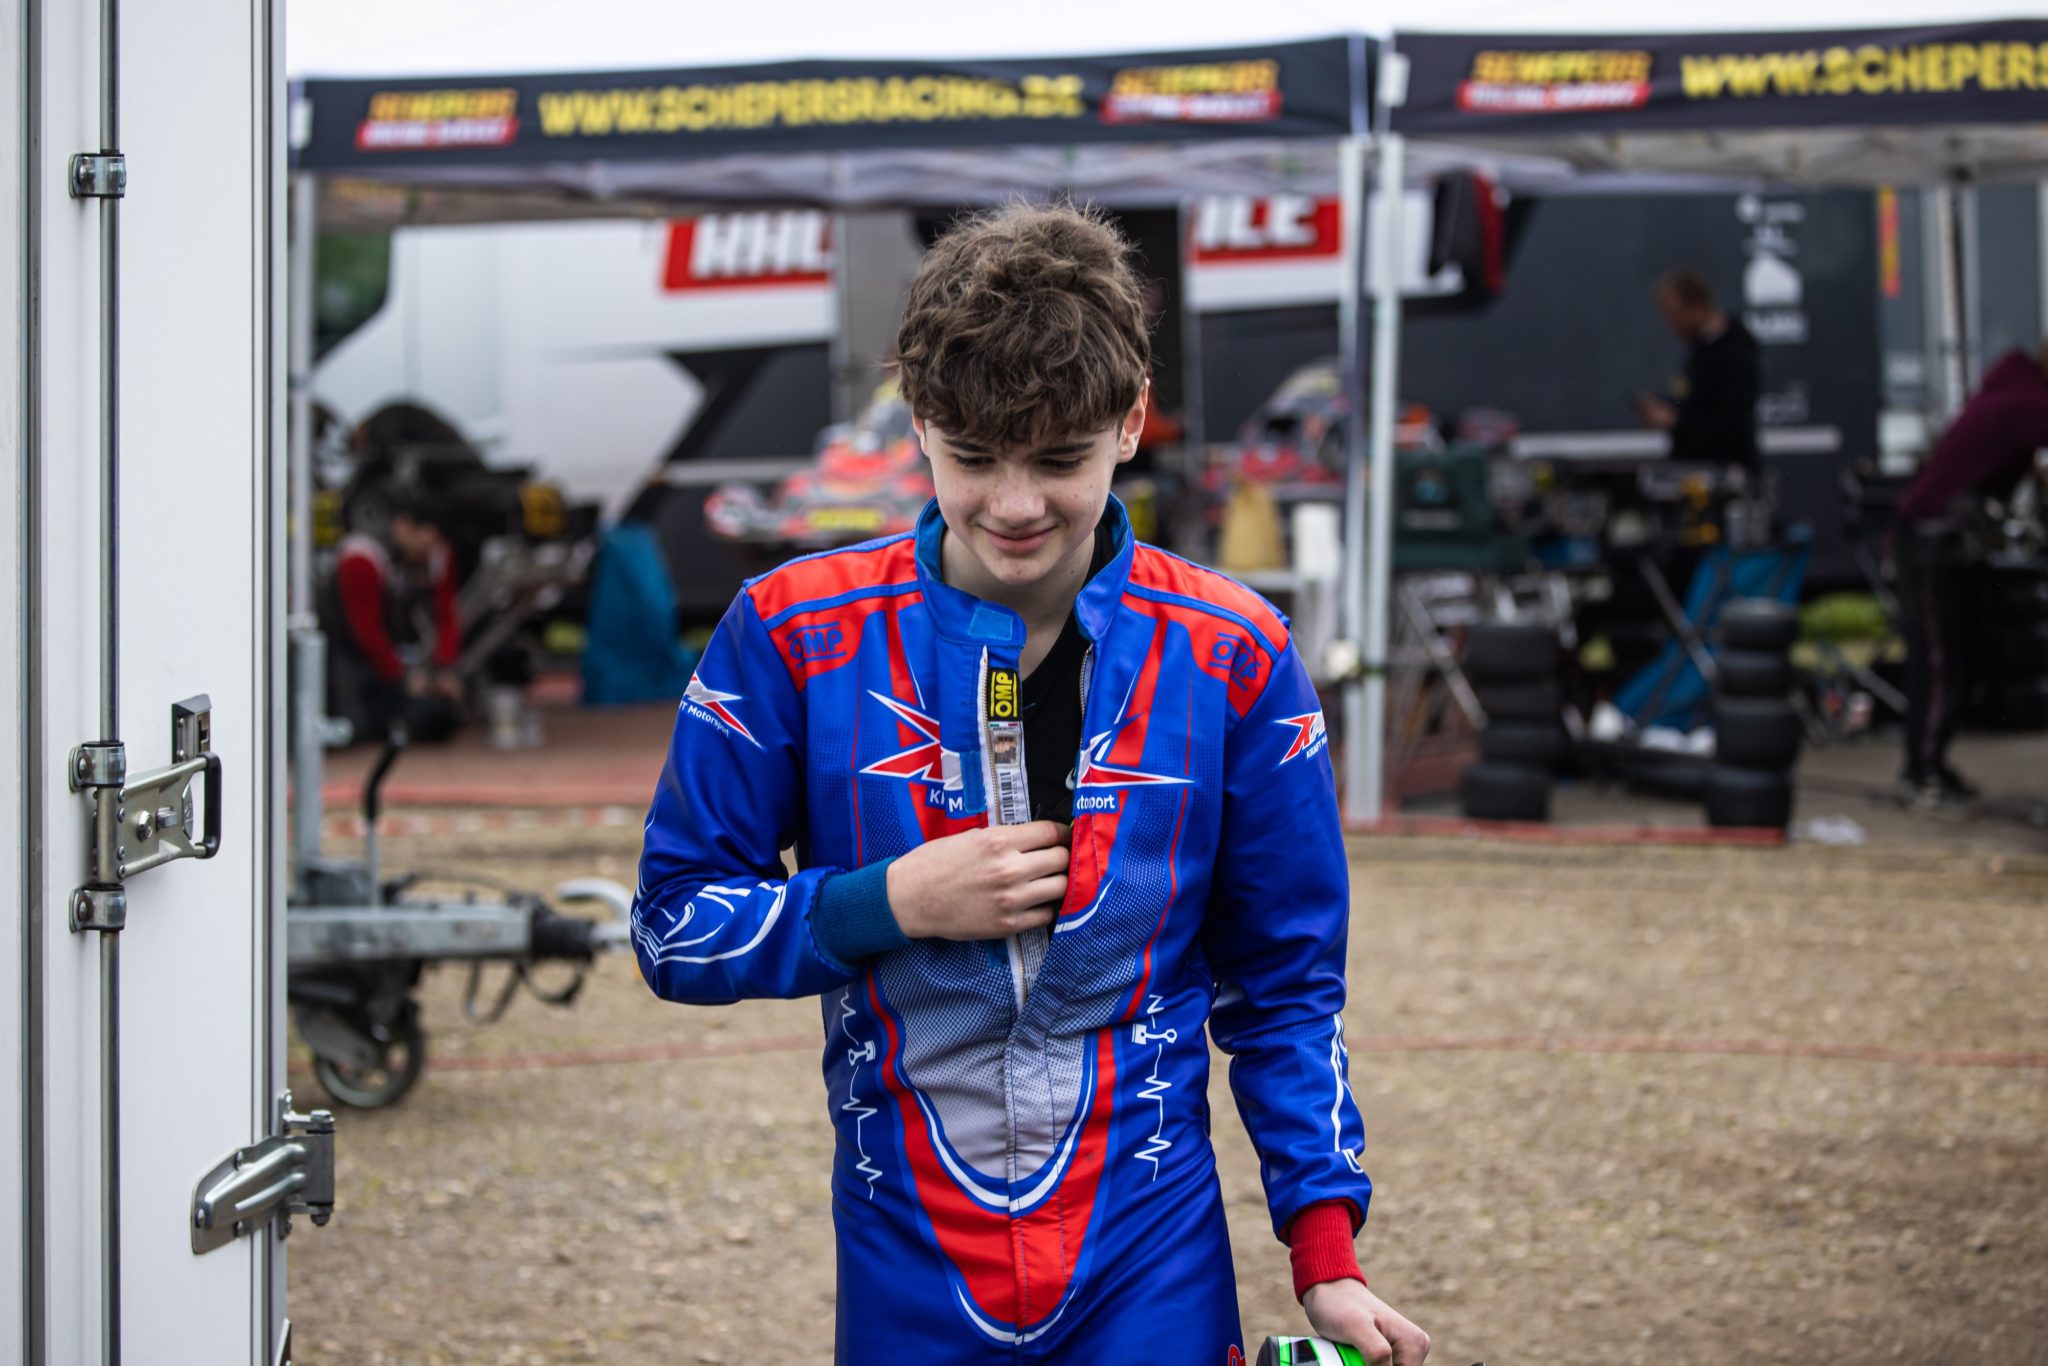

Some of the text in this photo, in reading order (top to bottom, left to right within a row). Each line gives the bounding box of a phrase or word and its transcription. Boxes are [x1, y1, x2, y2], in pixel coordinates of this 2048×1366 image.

[789, 628, 843, 660] OMP
[995, 671, 1013, 717] OMP
[688, 705, 730, 737] Motorsport
